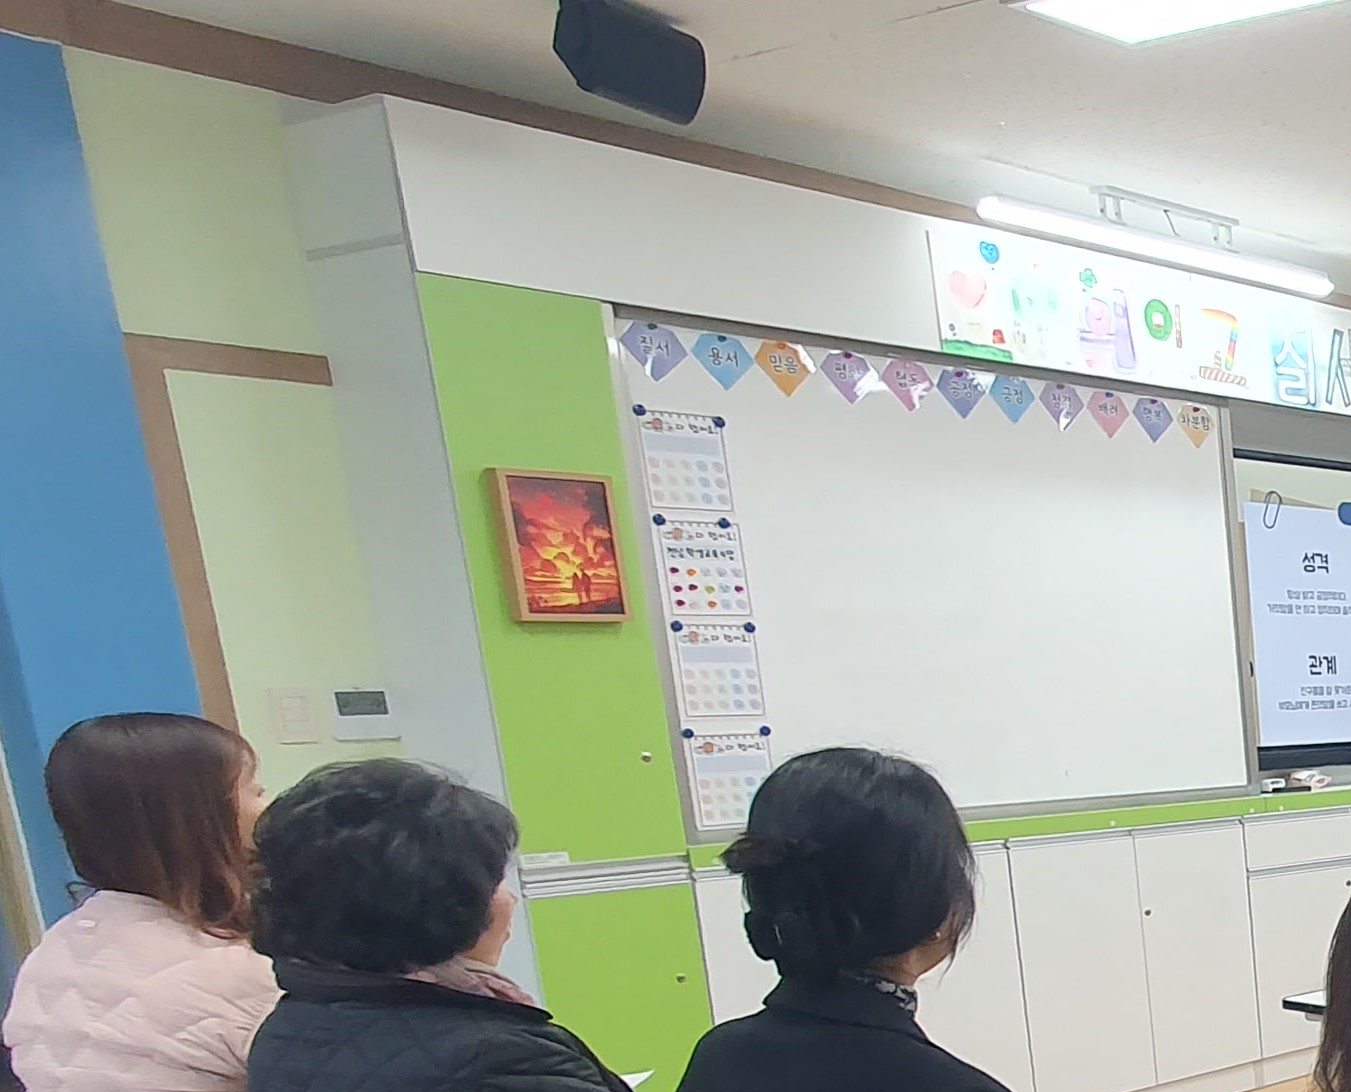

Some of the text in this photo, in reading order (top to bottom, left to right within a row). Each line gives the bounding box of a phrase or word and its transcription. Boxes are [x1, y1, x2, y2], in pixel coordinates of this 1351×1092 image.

[639, 335, 670, 357] 질서
[708, 347, 739, 368] 용서
[769, 354, 798, 374] 믿음
[1181, 415, 1211, 432] 차분함
[1302, 552, 1329, 574] 성격
[1308, 655, 1338, 676] 관계
